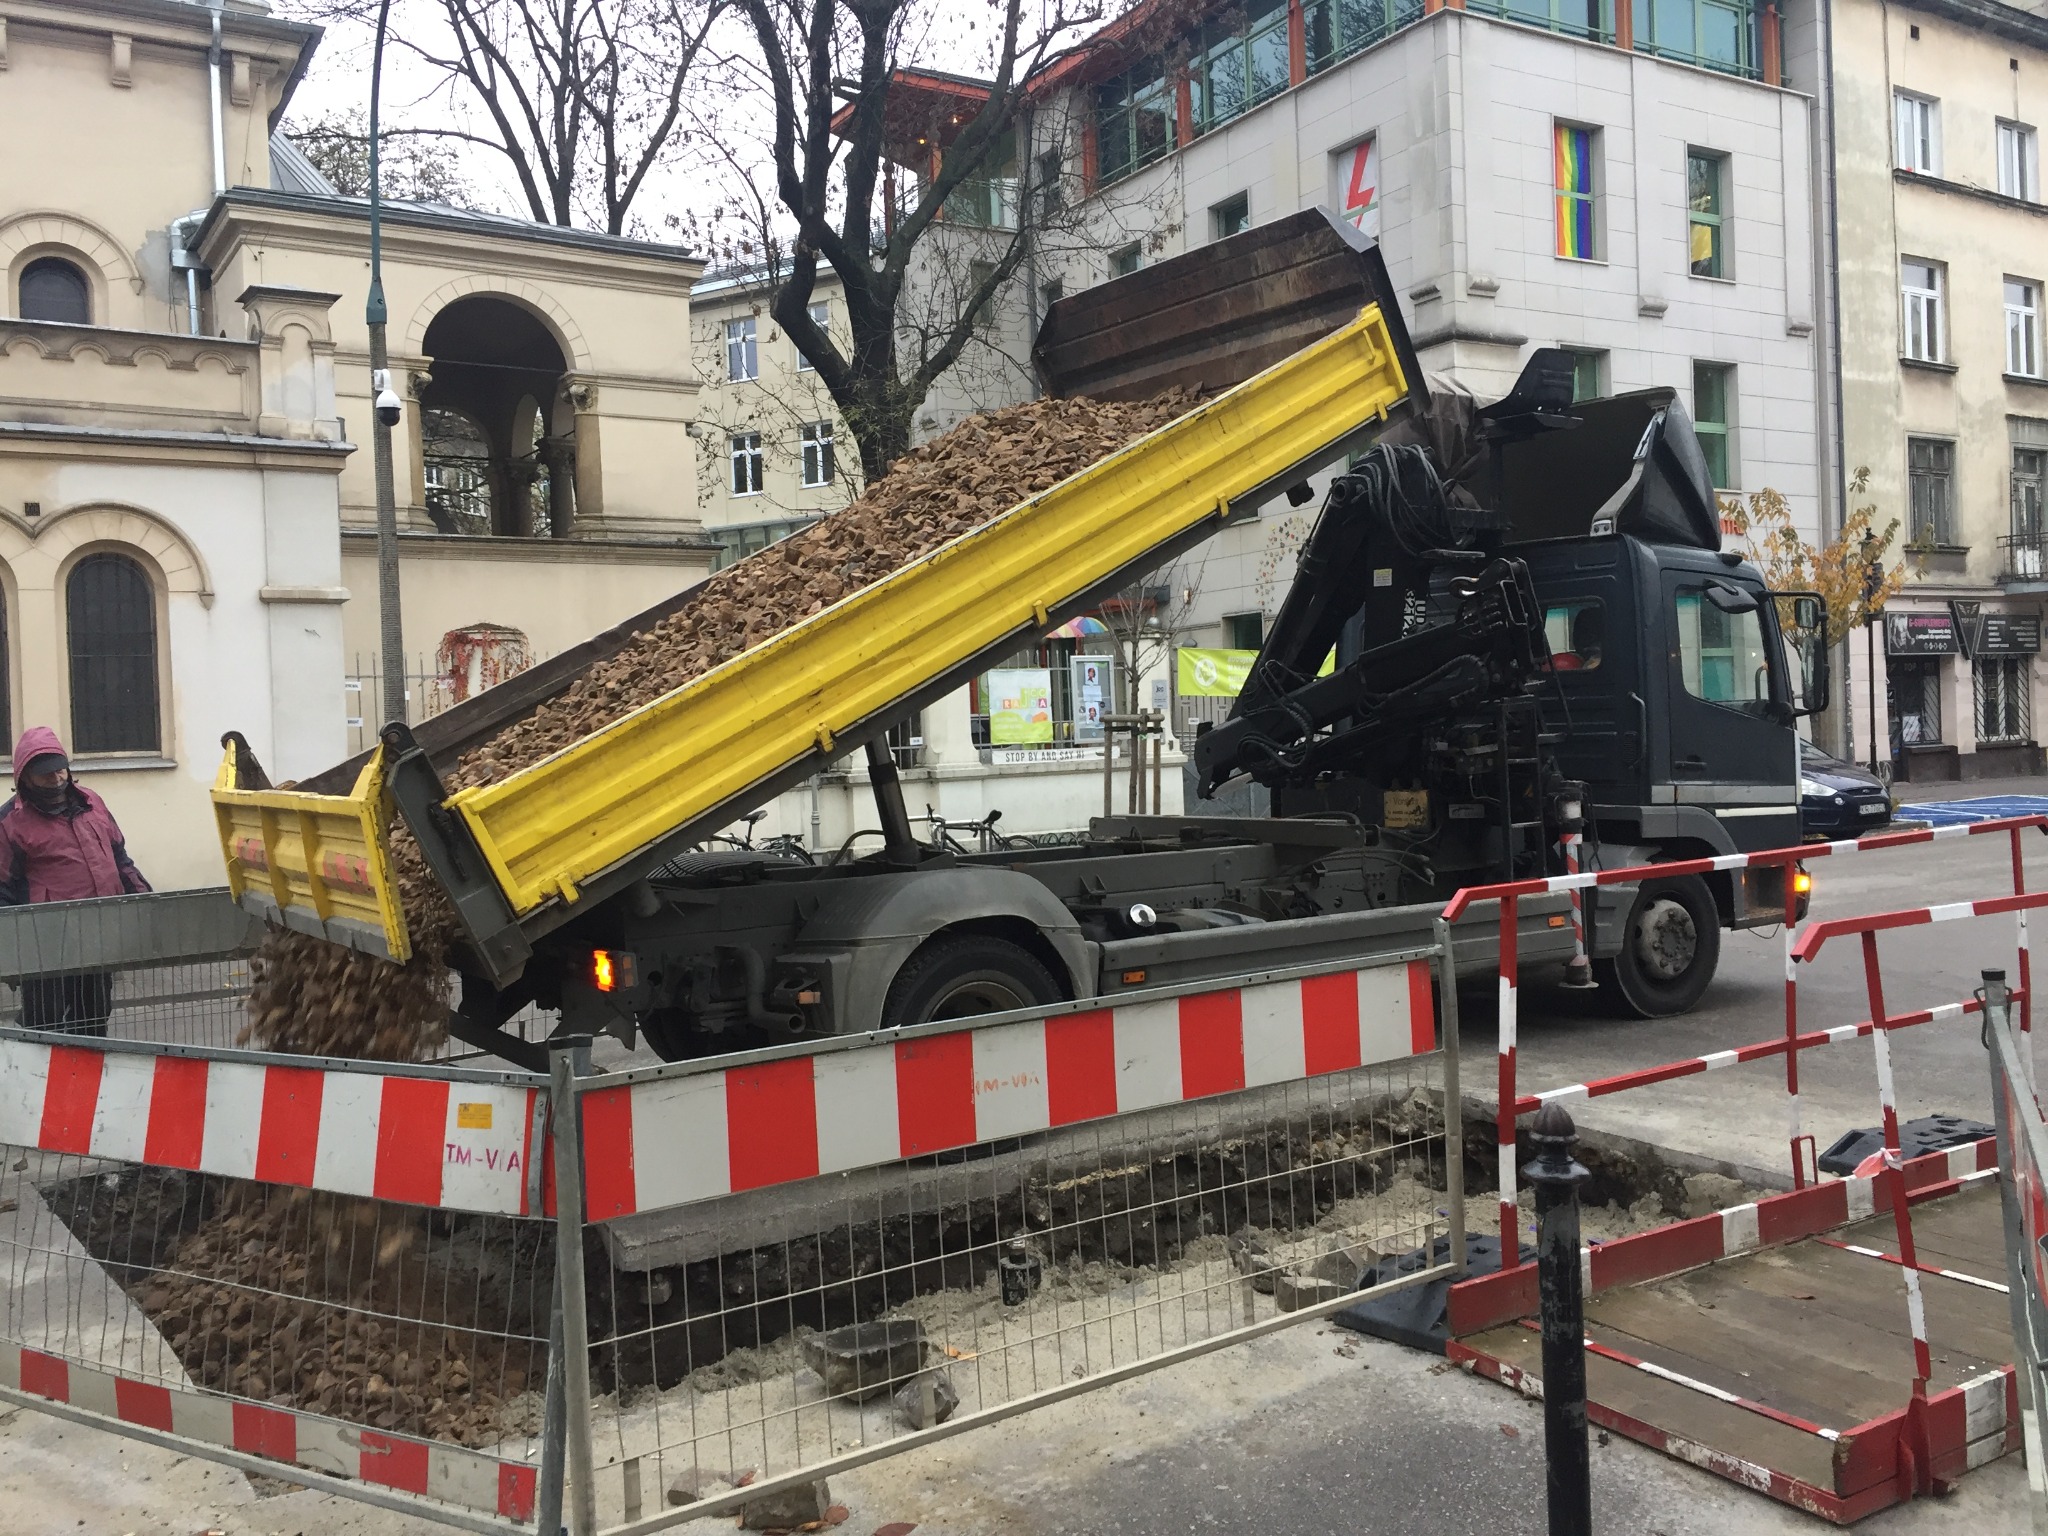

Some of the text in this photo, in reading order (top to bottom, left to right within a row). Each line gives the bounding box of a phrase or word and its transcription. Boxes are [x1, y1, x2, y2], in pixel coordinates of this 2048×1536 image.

[1005, 752, 1025, 763] STOP
[1028, 751, 1038, 762] BY
[1041, 751, 1057, 761] AND
[1059, 750, 1073, 760] SAY
